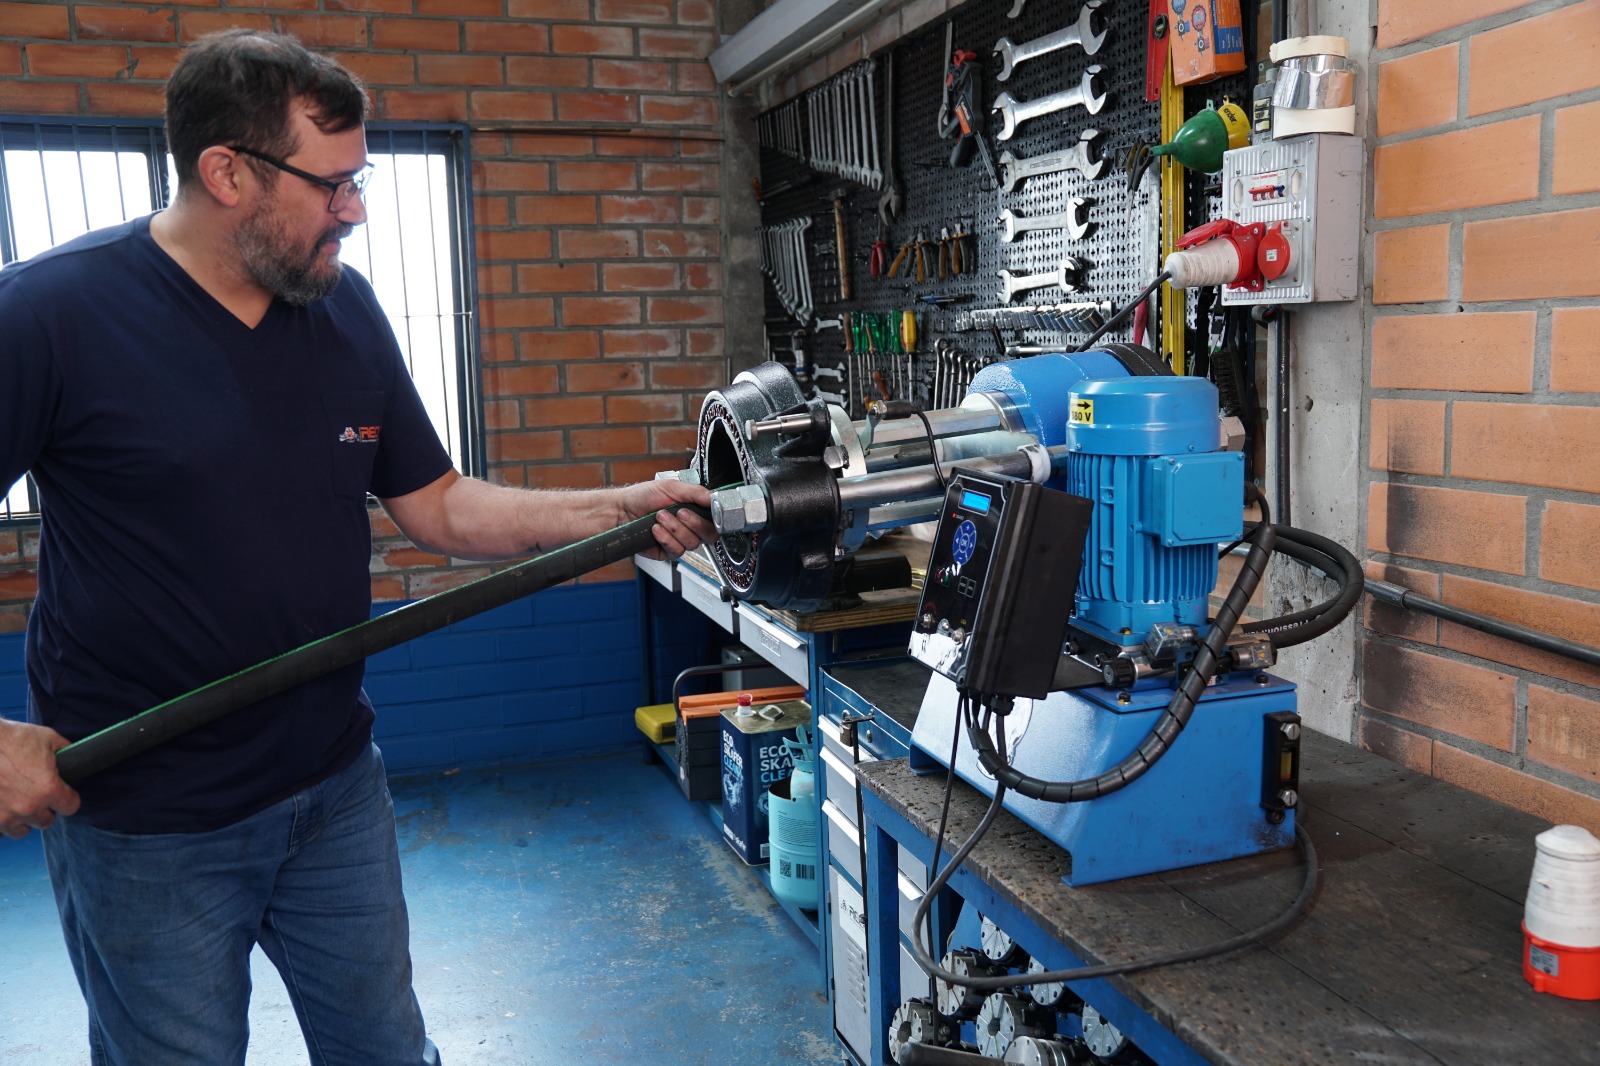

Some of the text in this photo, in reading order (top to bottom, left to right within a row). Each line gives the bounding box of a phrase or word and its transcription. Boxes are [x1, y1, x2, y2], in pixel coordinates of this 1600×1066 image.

[1085, 412, 1091, 422] V
[722, 729, 734, 747] ECO
[759, 745, 789, 759] ECO
